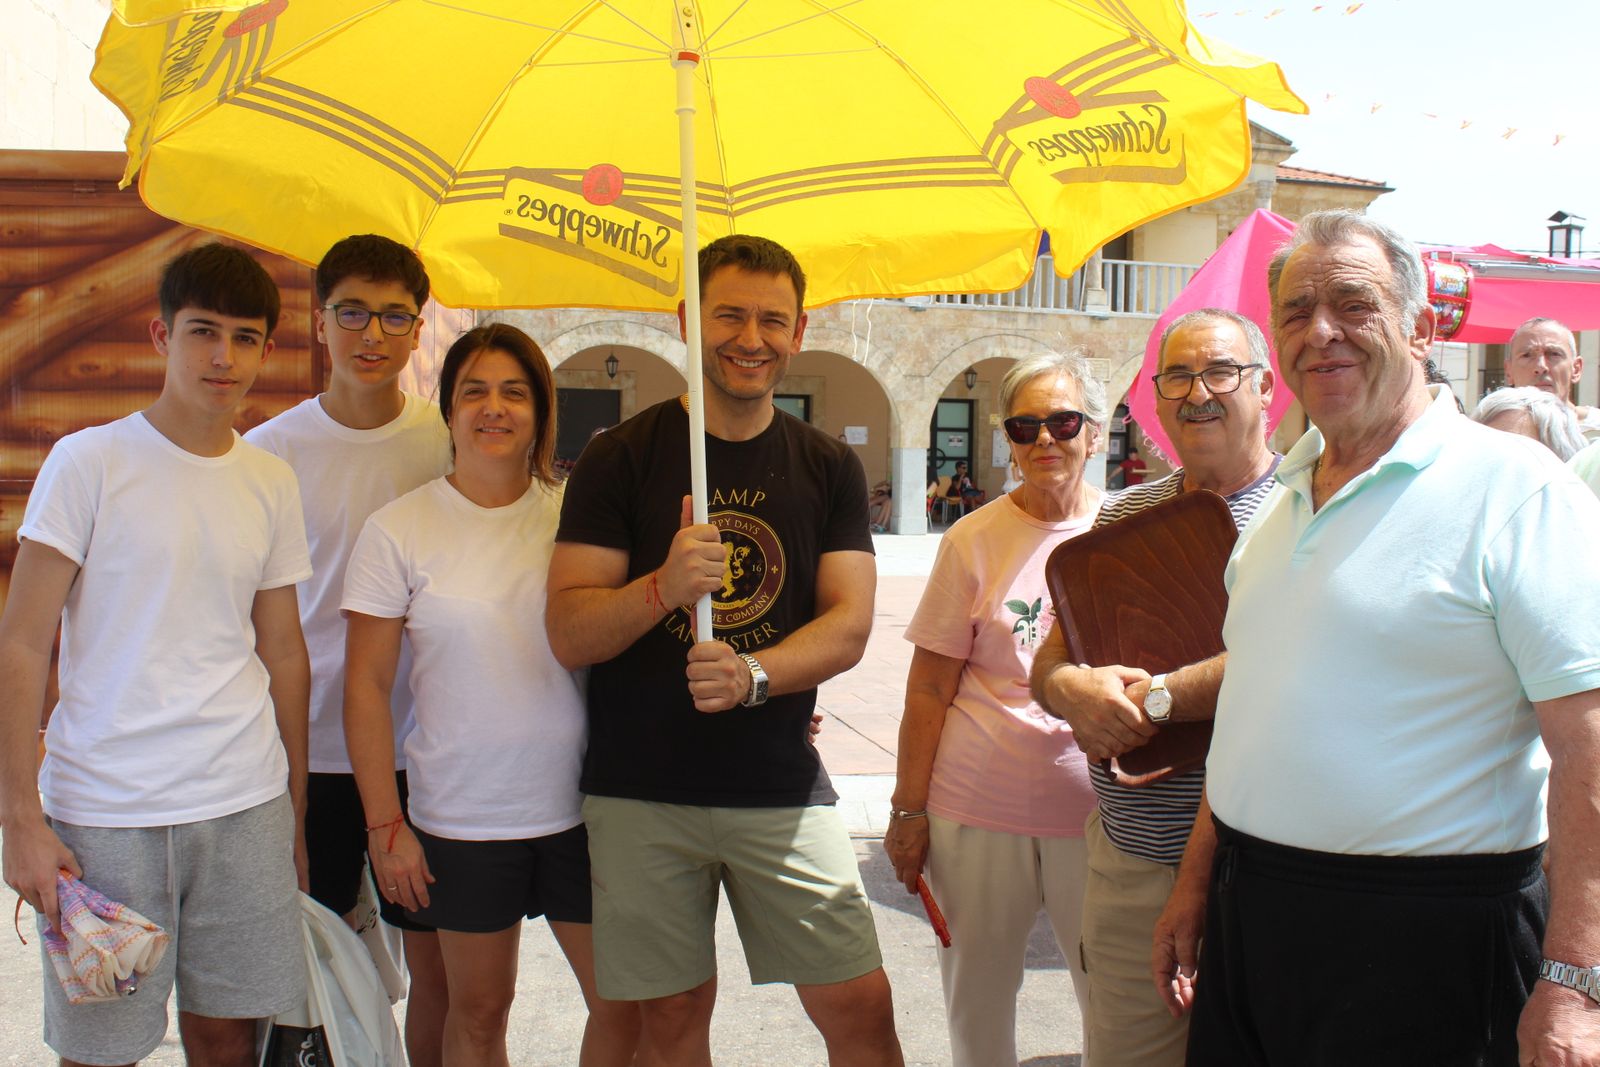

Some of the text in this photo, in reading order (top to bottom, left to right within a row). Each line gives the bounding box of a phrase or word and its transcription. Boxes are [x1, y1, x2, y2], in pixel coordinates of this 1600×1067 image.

[707, 487, 766, 507] AMP
[734, 519, 761, 535] DAYS
[752, 563, 762, 573] 16
[725, 592, 770, 623] COMPANY
